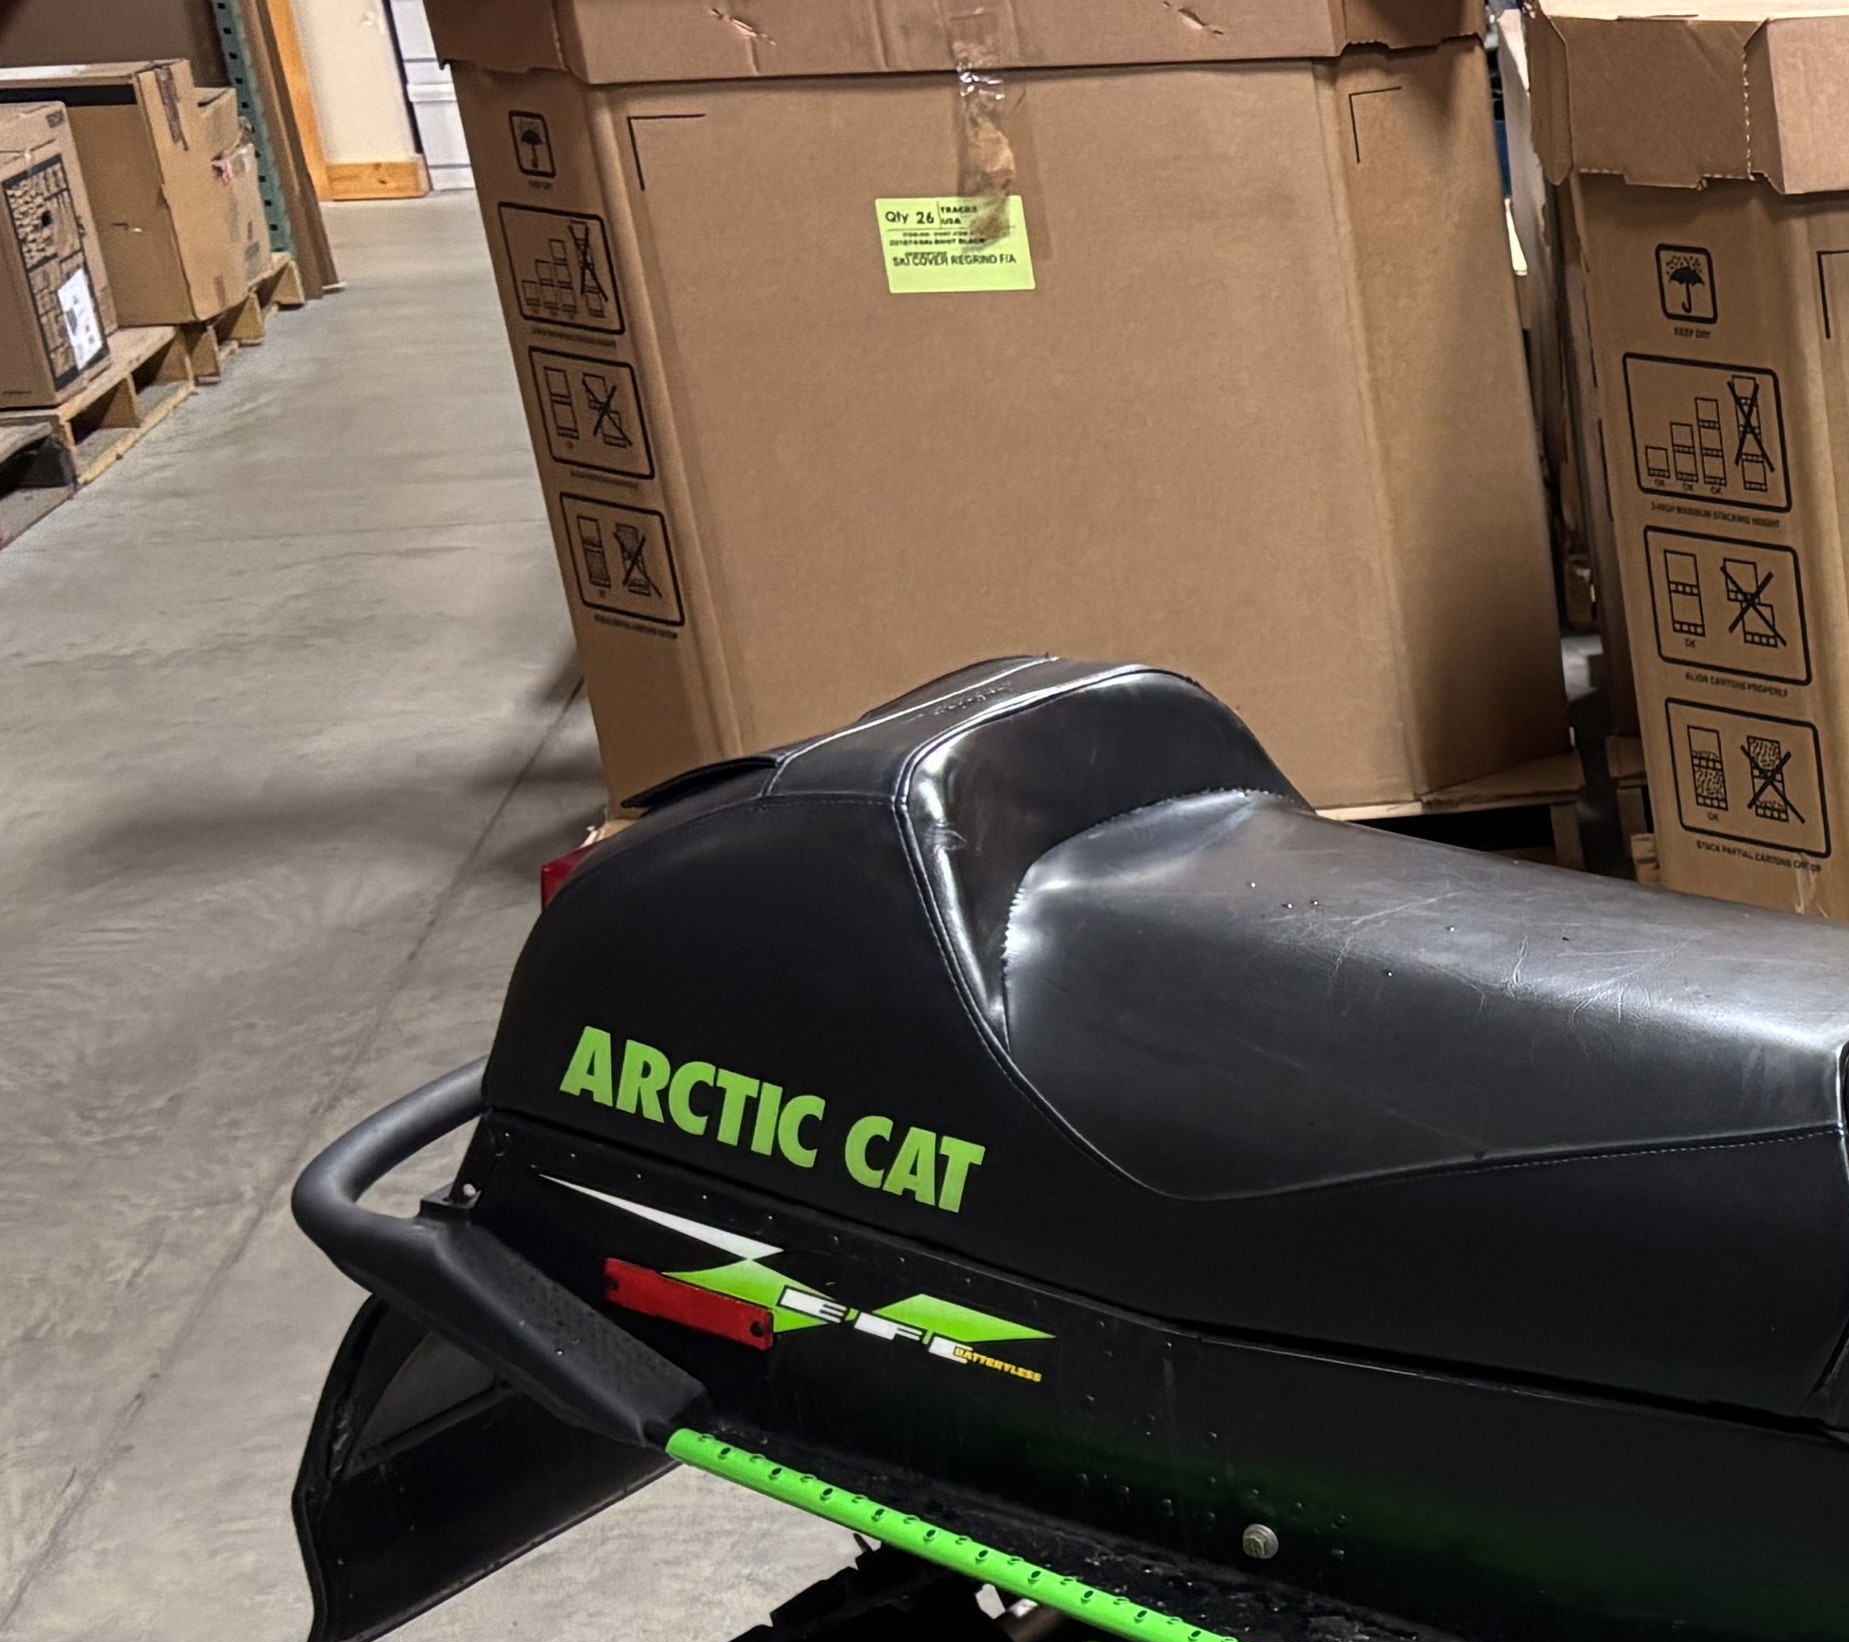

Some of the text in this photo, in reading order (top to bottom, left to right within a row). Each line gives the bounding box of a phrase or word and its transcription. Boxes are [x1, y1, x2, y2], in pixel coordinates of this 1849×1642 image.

[885, 211, 935, 225] Qty 26
[912, 254, 949, 267] COVER
[951, 254, 998, 265] REGRIND
[560, 1025, 985, 1213] ARCTIC CAT
[954, 1346, 1042, 1383] BATTERYLESS
